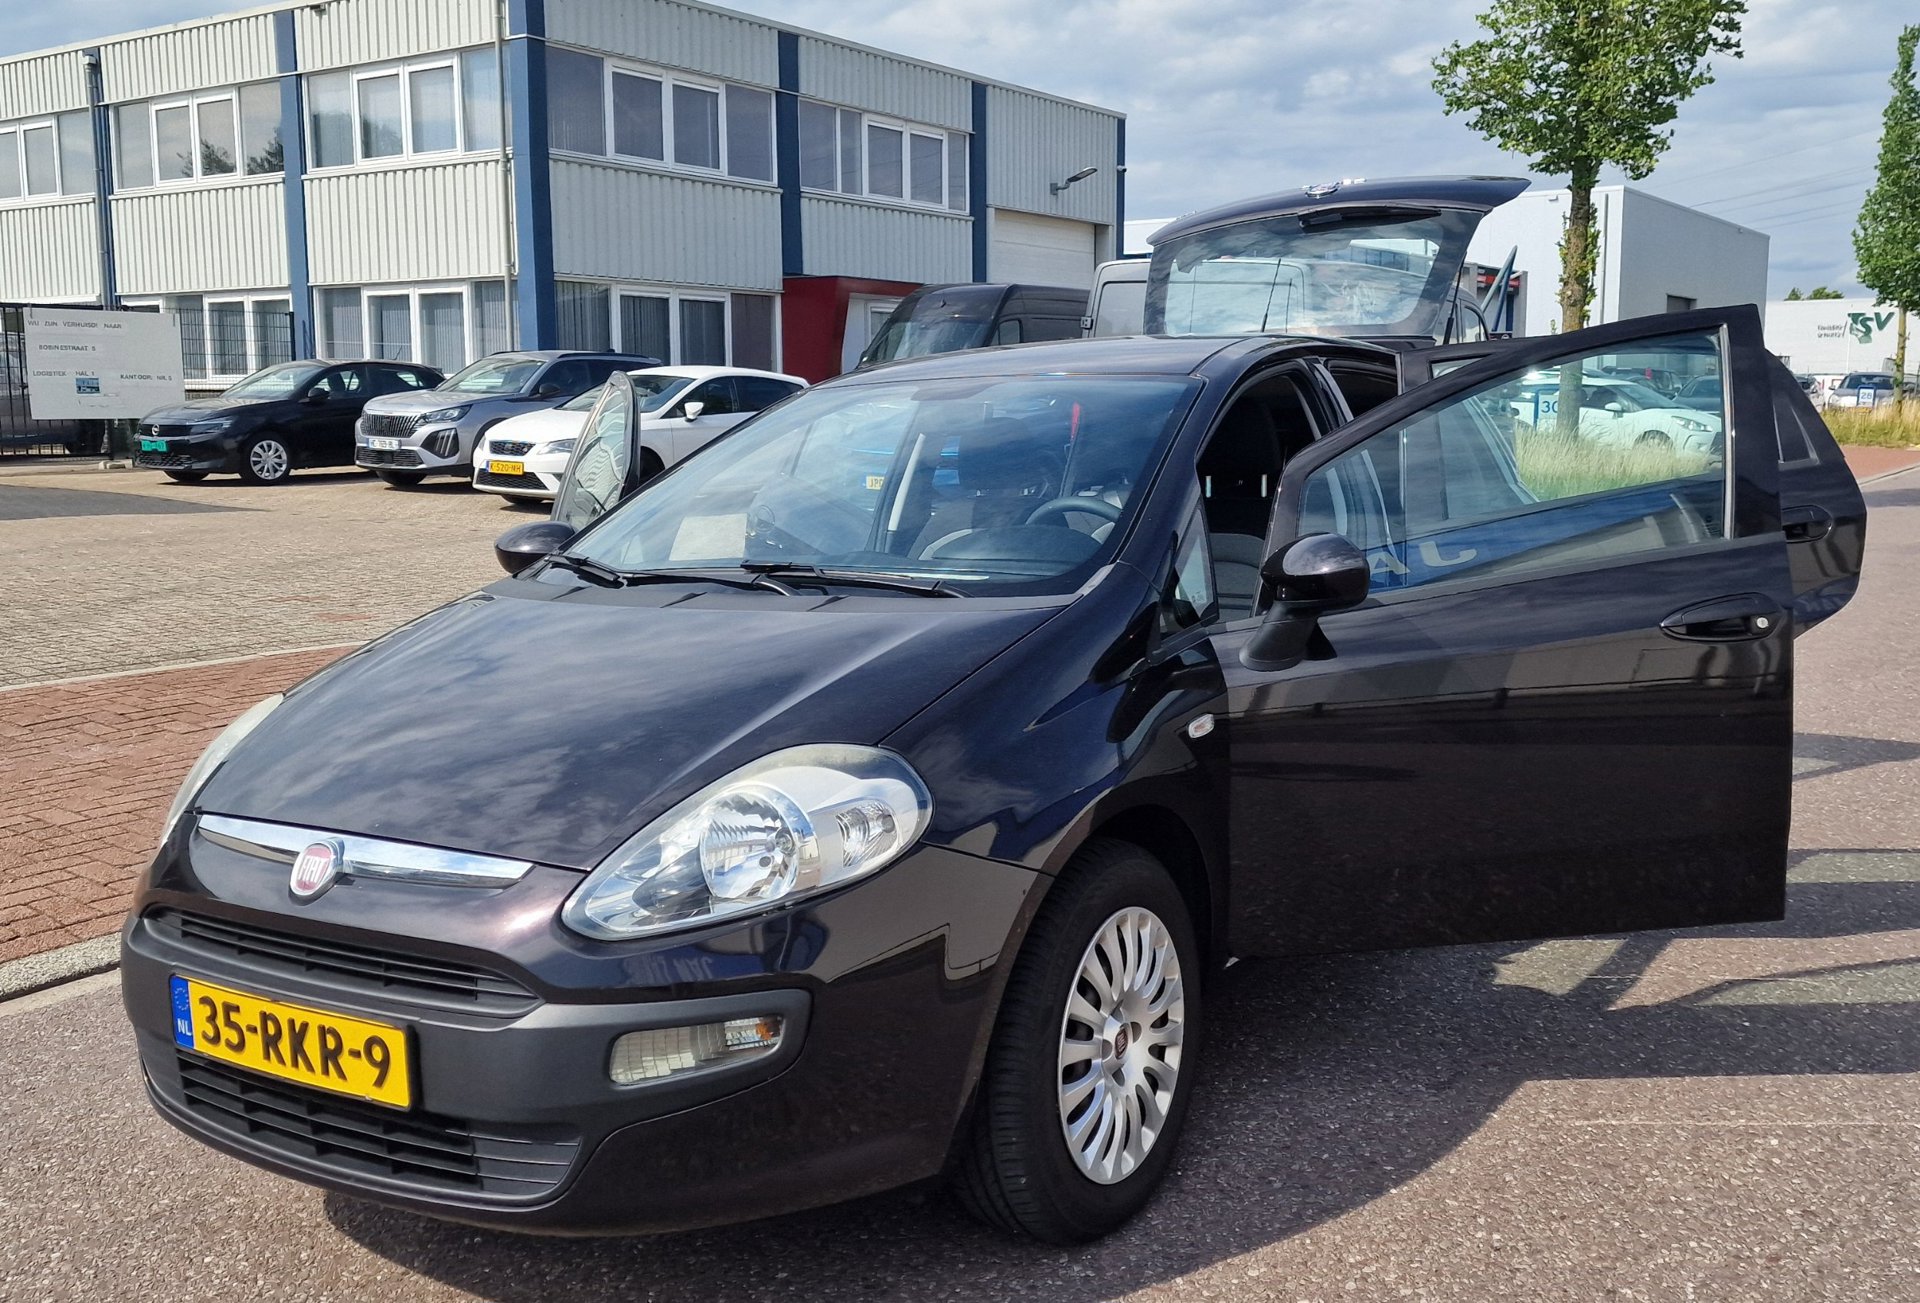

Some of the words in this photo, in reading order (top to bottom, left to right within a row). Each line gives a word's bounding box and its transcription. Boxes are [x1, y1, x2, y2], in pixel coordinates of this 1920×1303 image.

[1847, 311, 1895, 338] TSV
[298, 854, 331, 884] FIAT
[177, 1017, 193, 1037] NL
[198, 995, 391, 1089] 35-RKR-9
